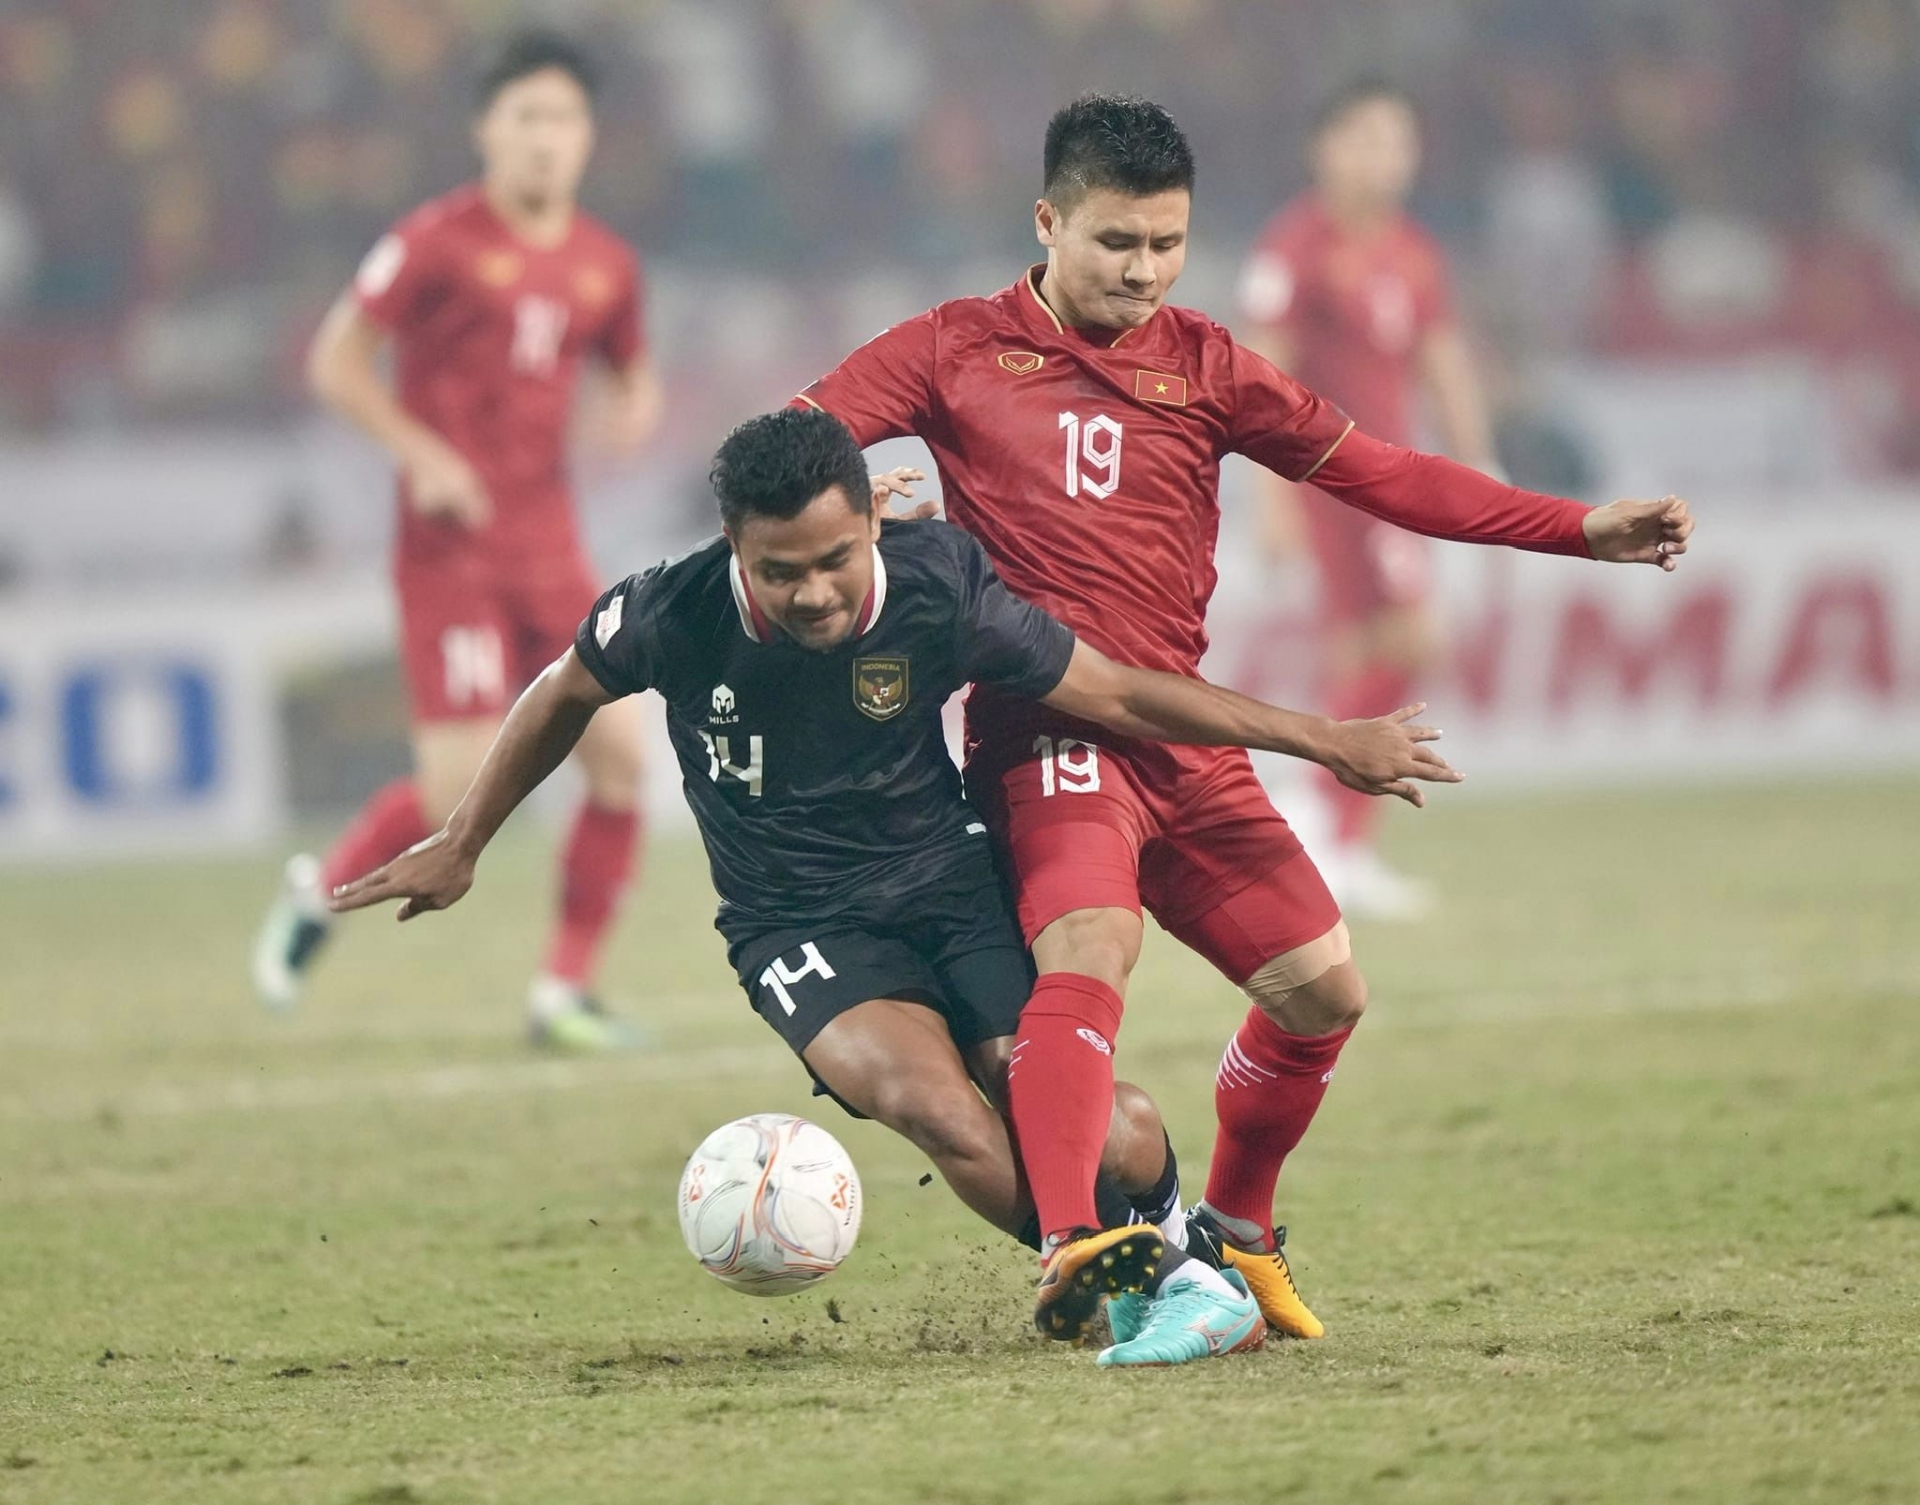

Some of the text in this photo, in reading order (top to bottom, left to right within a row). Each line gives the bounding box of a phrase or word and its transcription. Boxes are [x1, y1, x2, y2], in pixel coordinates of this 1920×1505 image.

[1058, 411, 1123, 500] 19
[709, 715, 739, 725] MILLS
[697, 730, 763, 797] 14
[1033, 735, 1101, 797] 19
[759, 941, 837, 1017] 14
